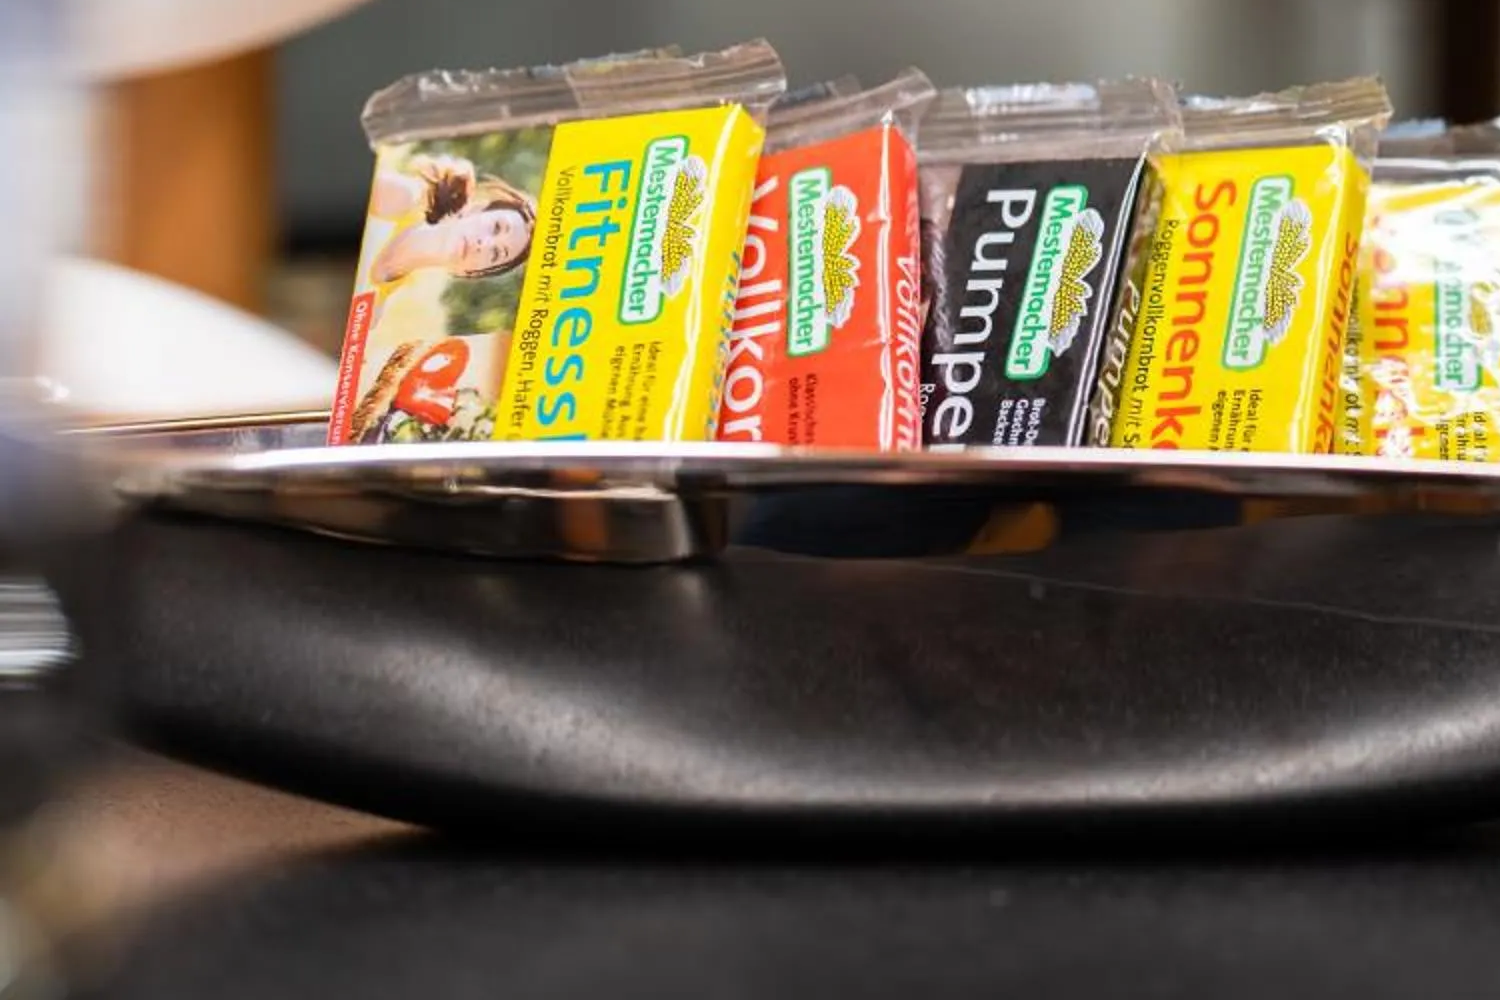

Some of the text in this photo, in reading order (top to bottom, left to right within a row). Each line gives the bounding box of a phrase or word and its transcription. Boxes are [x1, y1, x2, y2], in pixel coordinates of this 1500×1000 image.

[533, 275, 551, 302] mit
[536, 160, 632, 426] Fitness
[540, 165, 576, 269] Vollkornbrot
[628, 146, 679, 315] Mestemacher
[797, 178, 823, 347] Mestemacher
[1014, 195, 1074, 370] Mestemacher
[1229, 185, 1287, 361] Mestemacher
[929, 189, 1037, 452] Pumpe
[1132, 219, 1179, 392] Roggenvollkornbrot
[511, 379, 534, 428] Hafer
[1125, 397, 1144, 428] mit
[1246, 387, 1263, 421] Ideal
